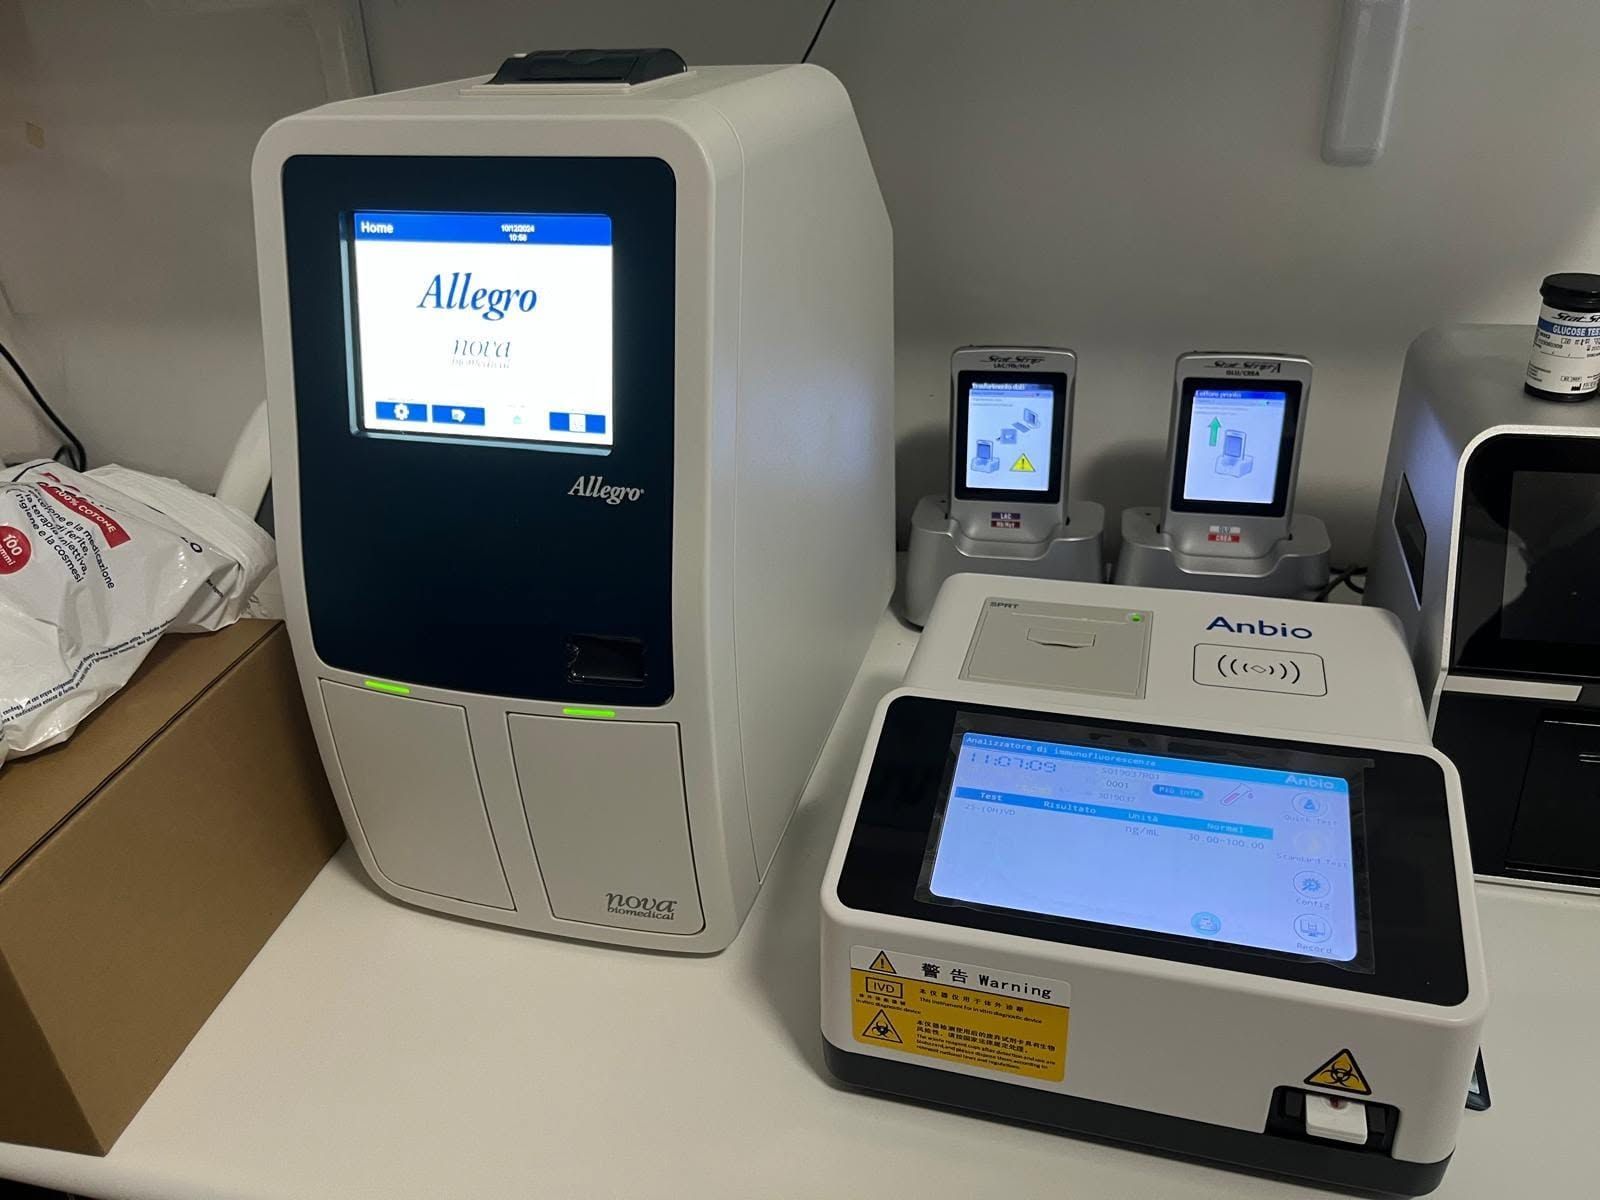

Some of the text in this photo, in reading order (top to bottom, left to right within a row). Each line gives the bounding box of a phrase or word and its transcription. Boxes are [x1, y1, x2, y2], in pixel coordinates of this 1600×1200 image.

[361, 221, 394, 234] Home
[501, 224, 535, 233] 10/12/2024
[416, 271, 538, 321] Allegro
[1552, 325, 1586, 336] GLUCOSE
[453, 339, 511, 358] nova
[567, 475, 643, 505] Allegro
[78, 504, 117, 534] COTONE
[3, 534, 23, 556] 100
[31, 503, 60, 536] terapia
[58, 535, 88, 576] iniettiva,
[65, 529, 89, 556] ferite,
[45, 534, 56, 546] la
[54, 543, 85, 584] cosmesi
[74, 522, 84, 532] la
[83, 529, 115, 589] medicazione
[1205, 615, 1313, 641] Anbio
[966, 737, 1156, 766] Analizzatore di immunofluorescenza
[971, 752, 1057, 773] 11:07:09
[1285, 775, 1334, 789] Anbio
[980, 792, 1003, 801] Test
[1044, 801, 1097, 814] Risultato
[605, 892, 678, 913] nova
[607, 906, 675, 920] biomedical
[1296, 942, 1332, 953] Record
[873, 981, 895, 994] IVD
[979, 974, 1052, 999] Warning
